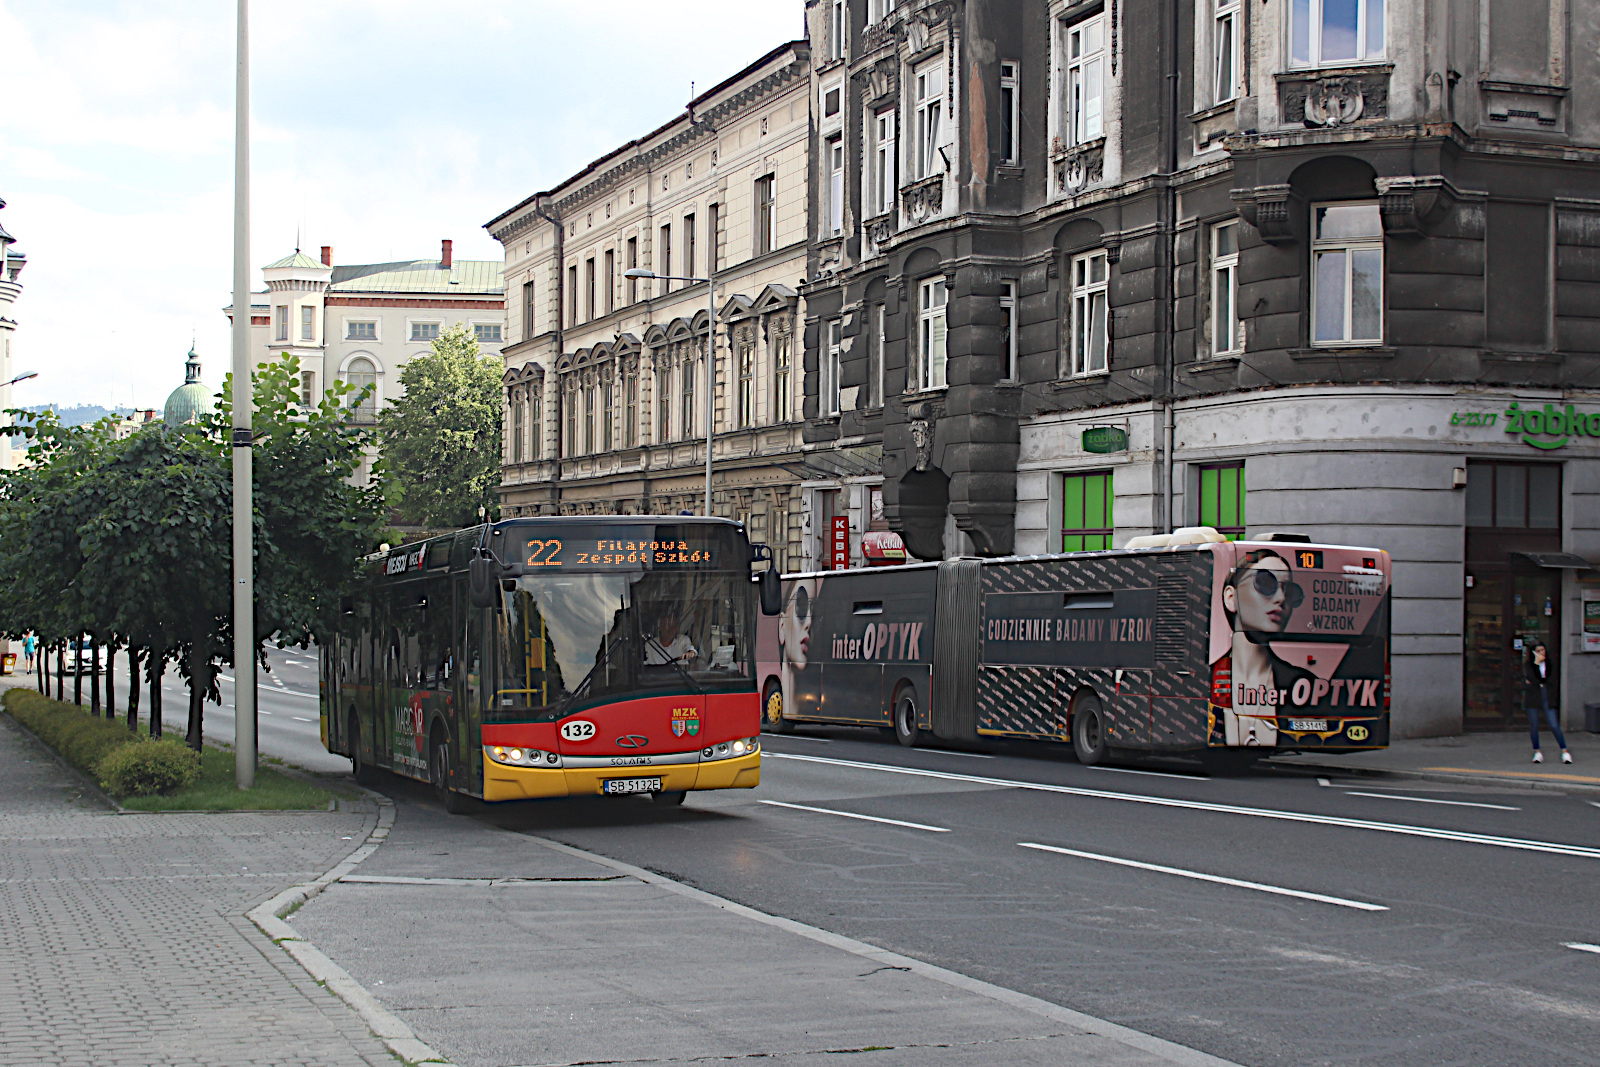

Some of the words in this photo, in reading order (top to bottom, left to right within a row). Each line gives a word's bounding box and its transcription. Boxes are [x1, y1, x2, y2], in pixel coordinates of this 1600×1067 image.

[597, 540, 689, 551] Filarowa
[527, 539, 563, 566] 22
[654, 550, 711, 563] Szkół
[1299, 552, 1315, 568] 10
[1312, 579, 1382, 597] CODZIENNIE
[1312, 597, 1361, 614] BADAMY
[1312, 614, 1355, 631] WZROK
[988, 619, 1051, 641] CODZIENNIE
[1056, 618, 1104, 641] BADAMY
[1110, 618, 1153, 642] WZROK
[673, 708, 698, 717] MZK
[563, 724, 593, 737] 132
[1348, 728, 1368, 739] 141
[610, 757, 652, 766] SOLARIS
[610, 781, 625, 792] SB
[628, 779, 659, 791] 5132E
